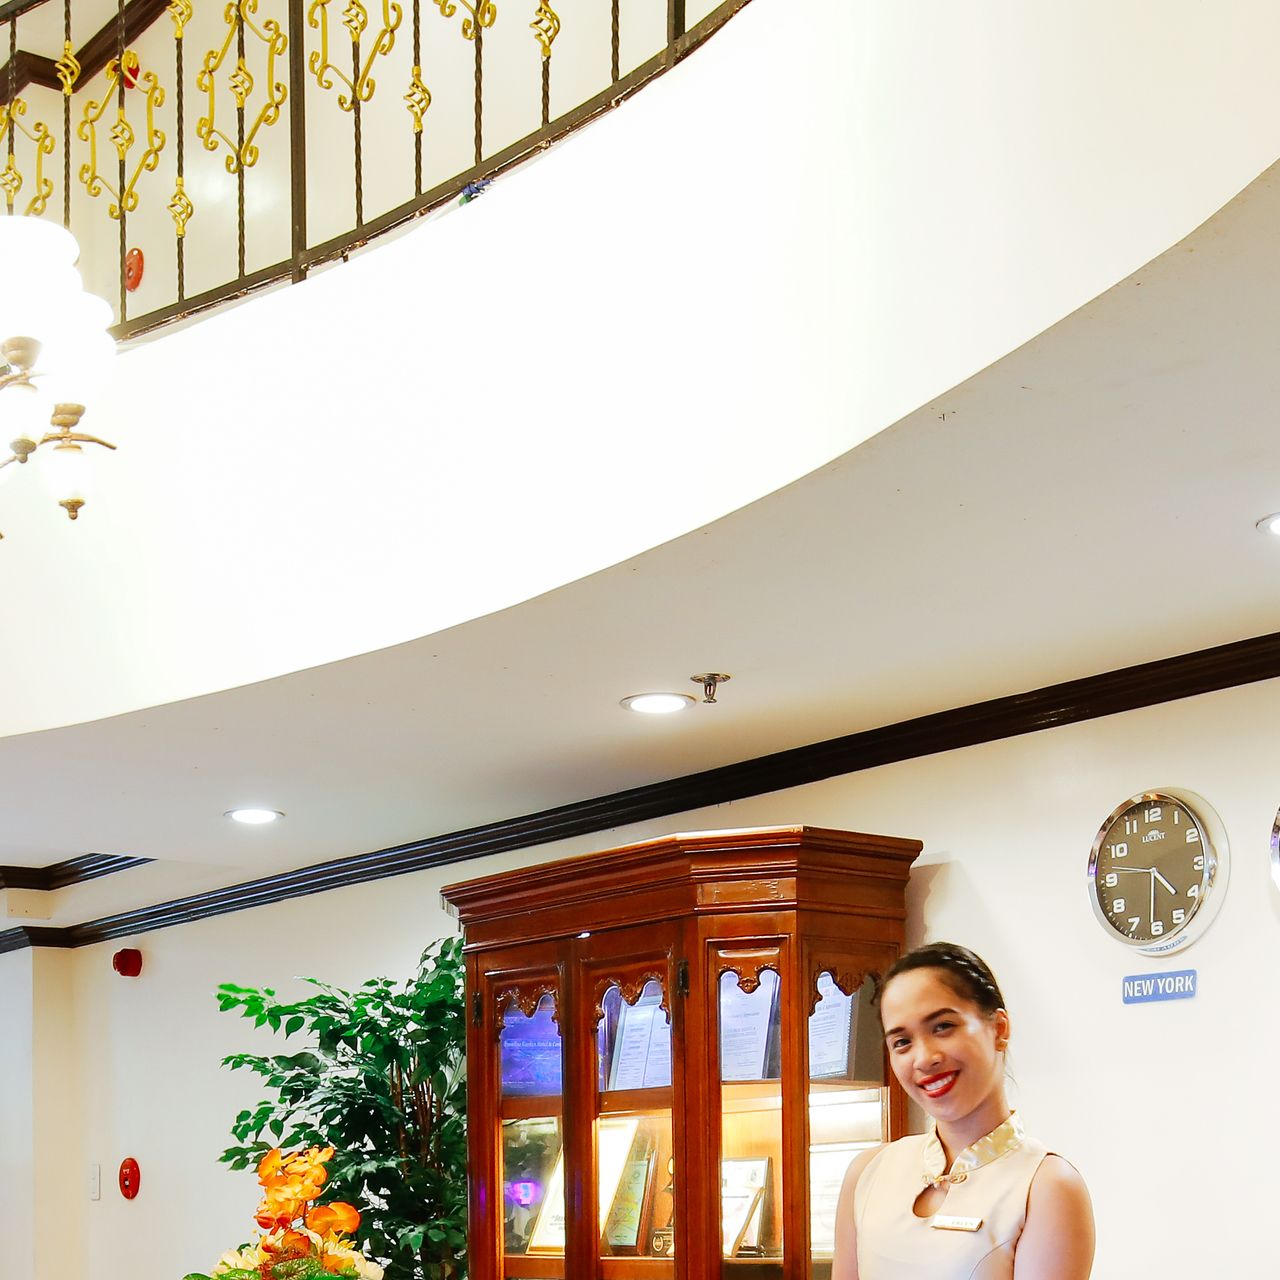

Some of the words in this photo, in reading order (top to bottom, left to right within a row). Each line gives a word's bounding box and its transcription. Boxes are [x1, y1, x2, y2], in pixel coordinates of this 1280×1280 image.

[1144, 807, 1162, 823] 12
[1173, 811, 1178, 825] 1
[1125, 820, 1138, 835] 11
[1142, 832, 1165, 843] LUCENT
[1186, 828, 1198, 843] 2
[1111, 843, 1127, 858] 10
[1193, 856, 1204, 871] 3
[1106, 873, 1117, 887] 9
[1187, 885, 1199, 898] 4
[1113, 899, 1125, 913] 8
[1172, 909, 1185, 924] 5
[1128, 917, 1140, 932] 7
[1151, 921, 1163, 936] 6
[1124, 979, 1154, 997] NEW
[1157, 975, 1194, 994] YORK
